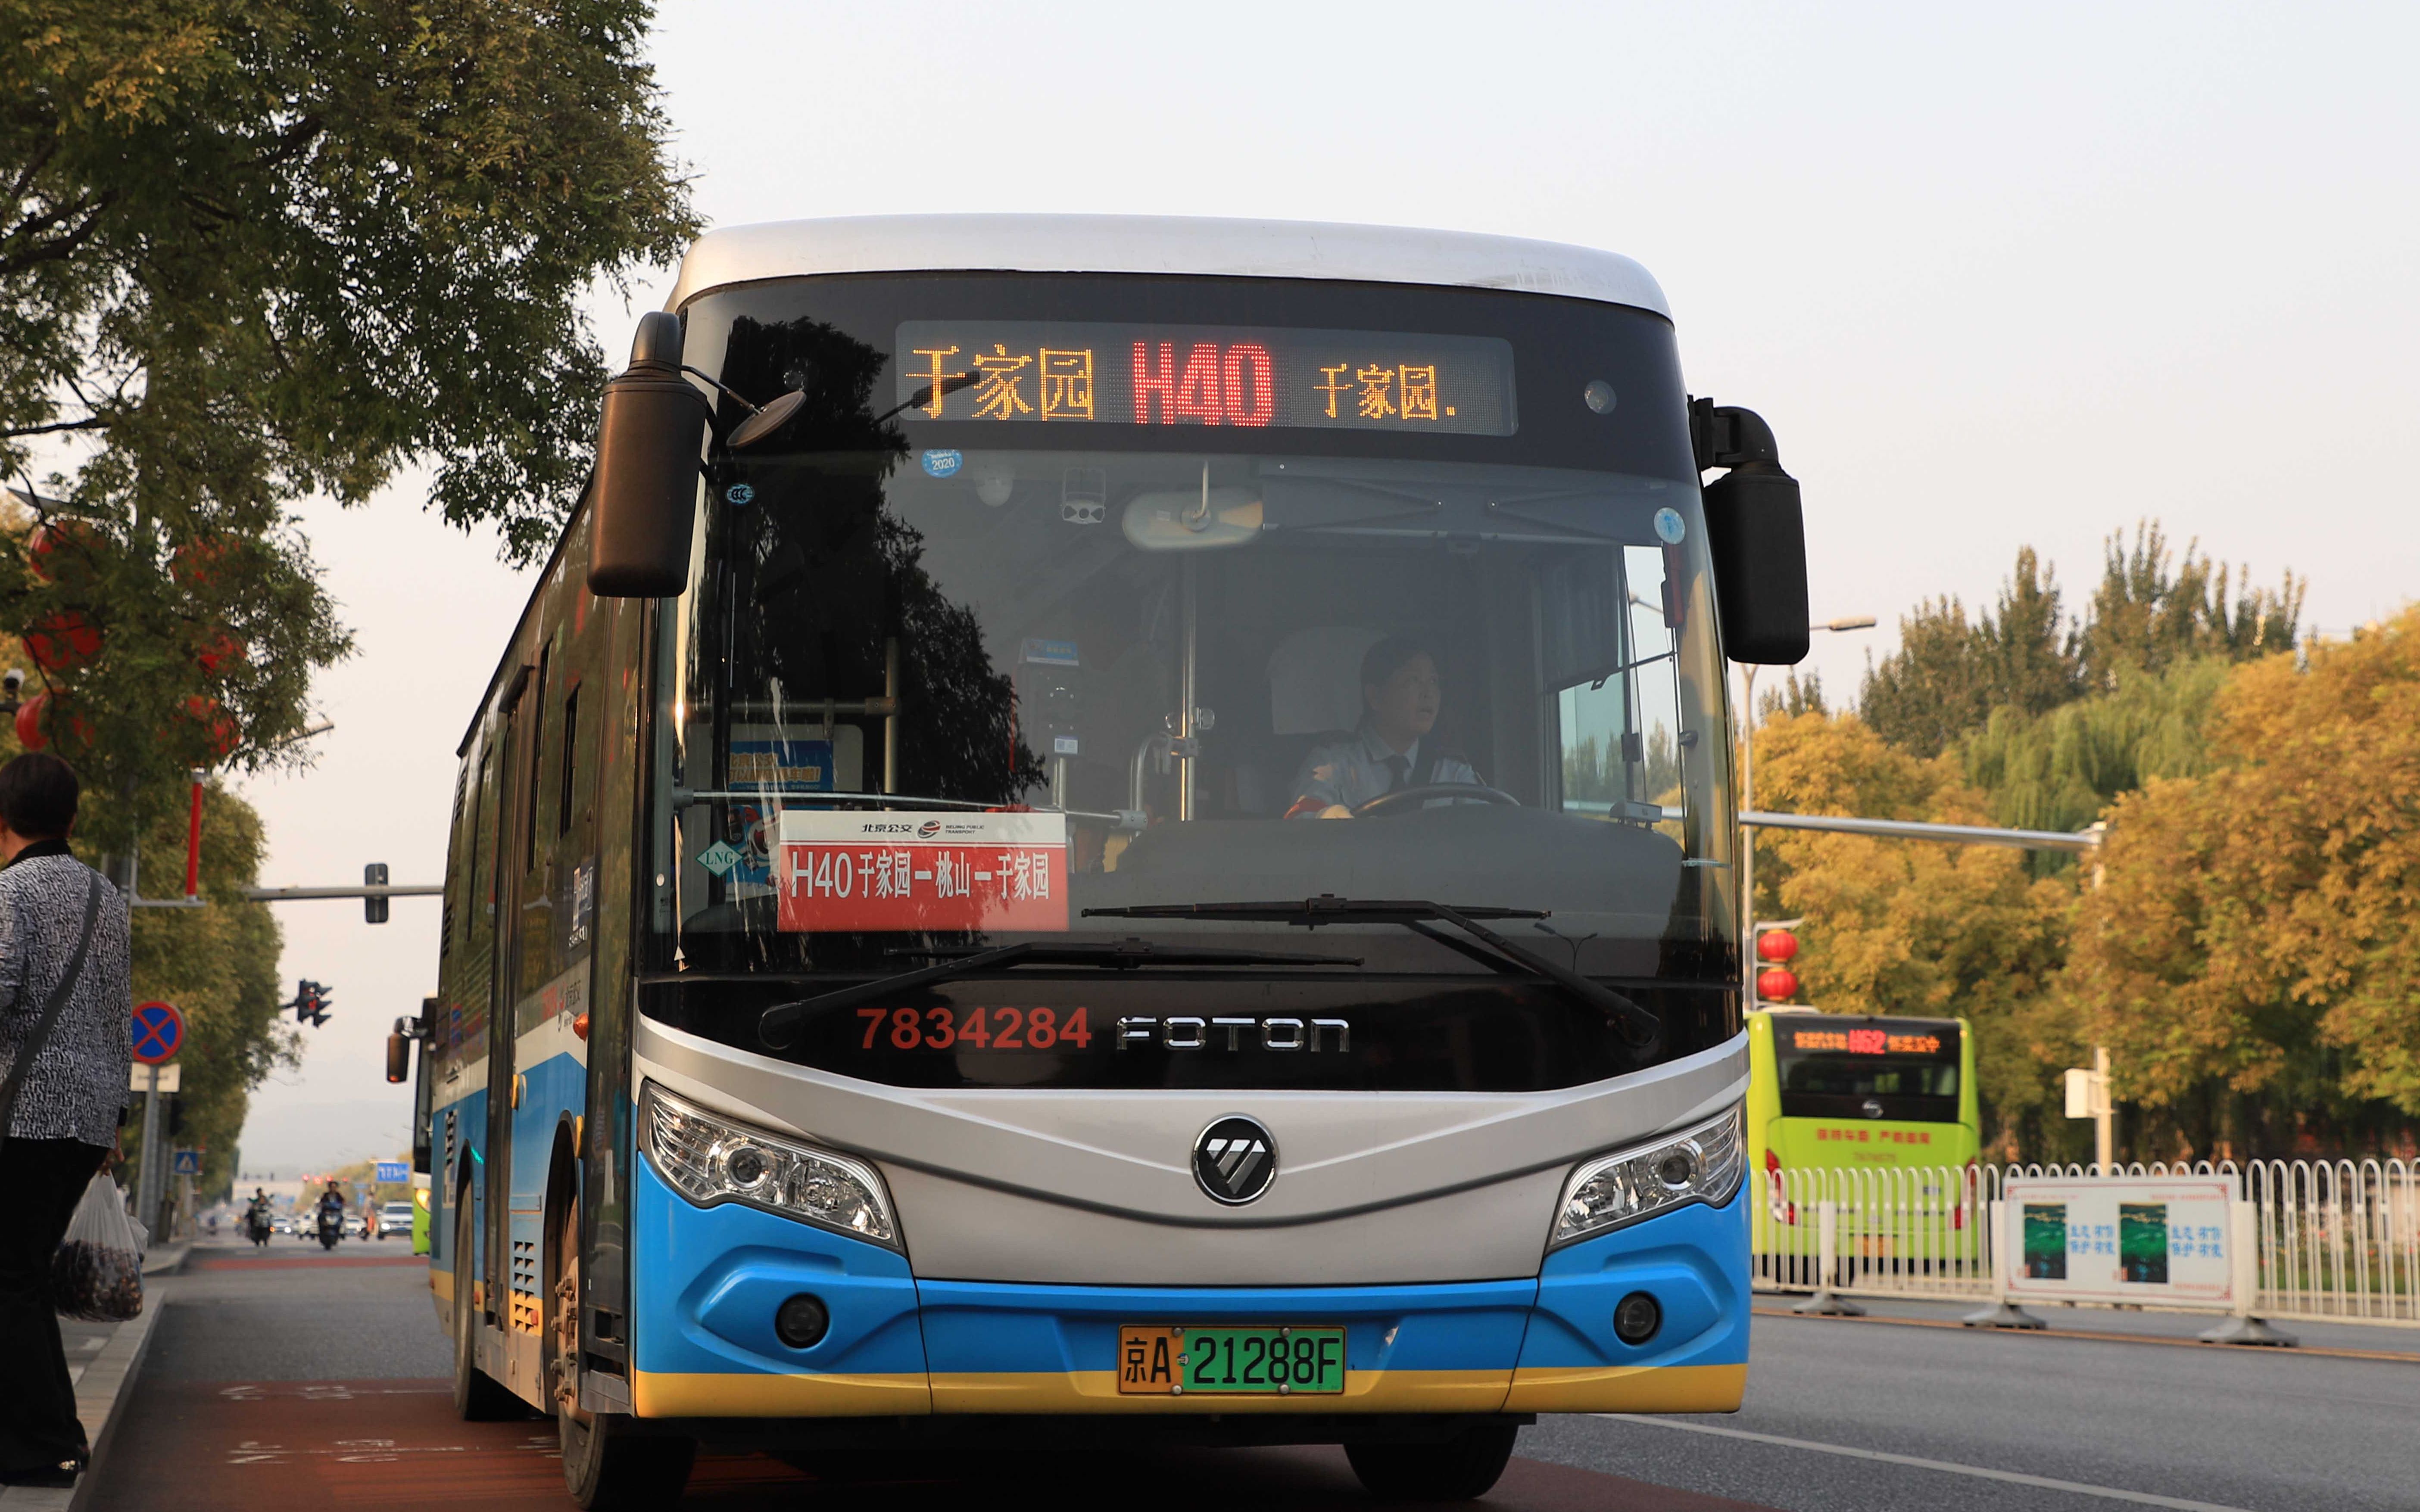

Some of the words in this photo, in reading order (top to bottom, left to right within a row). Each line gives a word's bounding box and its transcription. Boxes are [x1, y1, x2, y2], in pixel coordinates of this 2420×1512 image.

[905, 343, 1094, 421] 于家园
[1133, 342, 1273, 426] H40
[932, 457, 955, 470] 2020
[861, 824, 913, 833] 北京公交
[706, 852, 733, 865] LNG
[792, 851, 852, 898] H40
[857, 1006, 1091, 1050] 7834284
[1116, 1016, 1351, 1052] FOTON
[1125, 1337, 1172, 1384] 京A
[1193, 1337, 1340, 1384] 21288F
